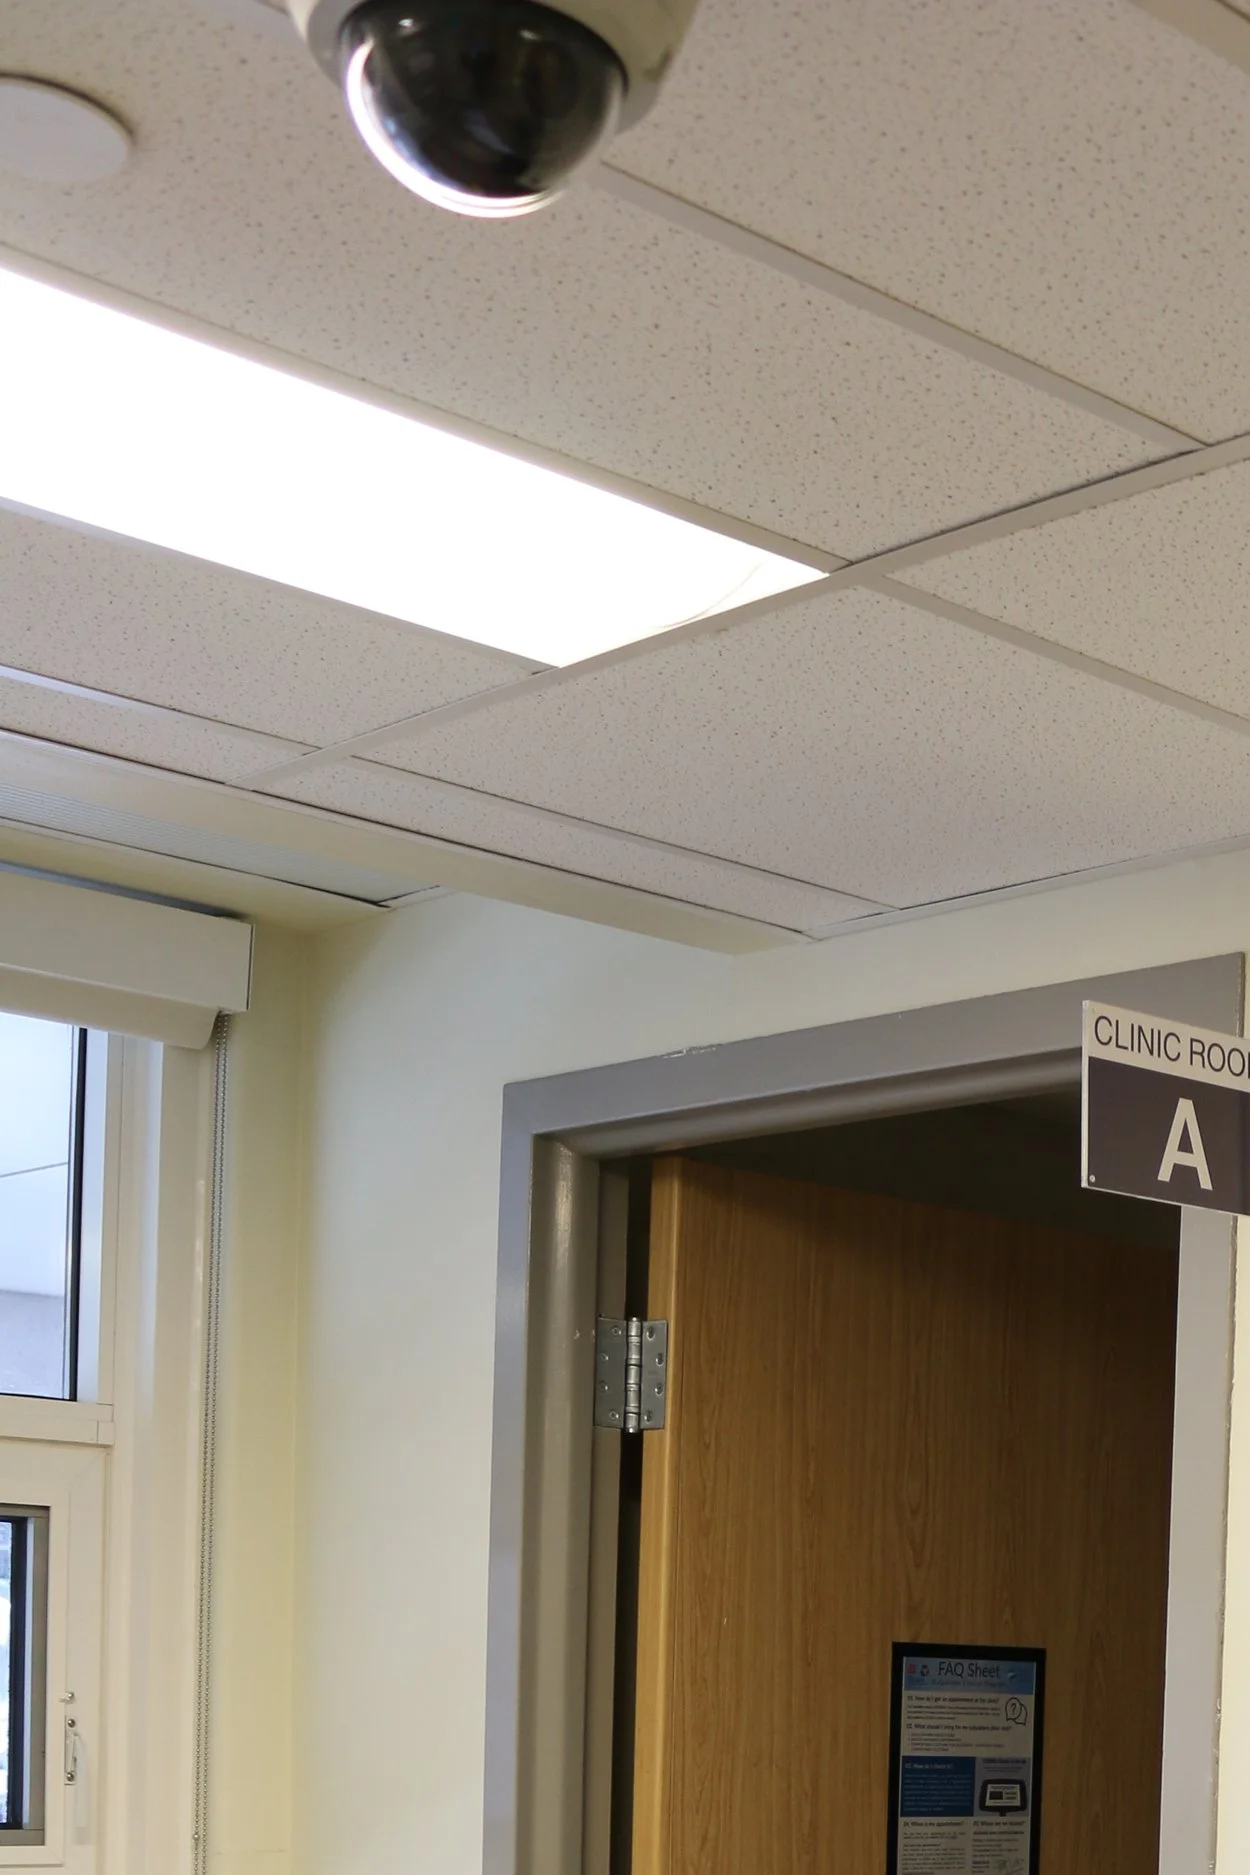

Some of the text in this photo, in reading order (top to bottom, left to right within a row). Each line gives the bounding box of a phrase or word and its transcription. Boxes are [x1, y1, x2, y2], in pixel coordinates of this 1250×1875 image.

[1094, 1016, 1181, 1062] CLINIC
[1157, 1097, 1213, 1191] A
[938, 1661, 964, 1679] FAQ
[967, 1662, 1000, 1678] Sheet
